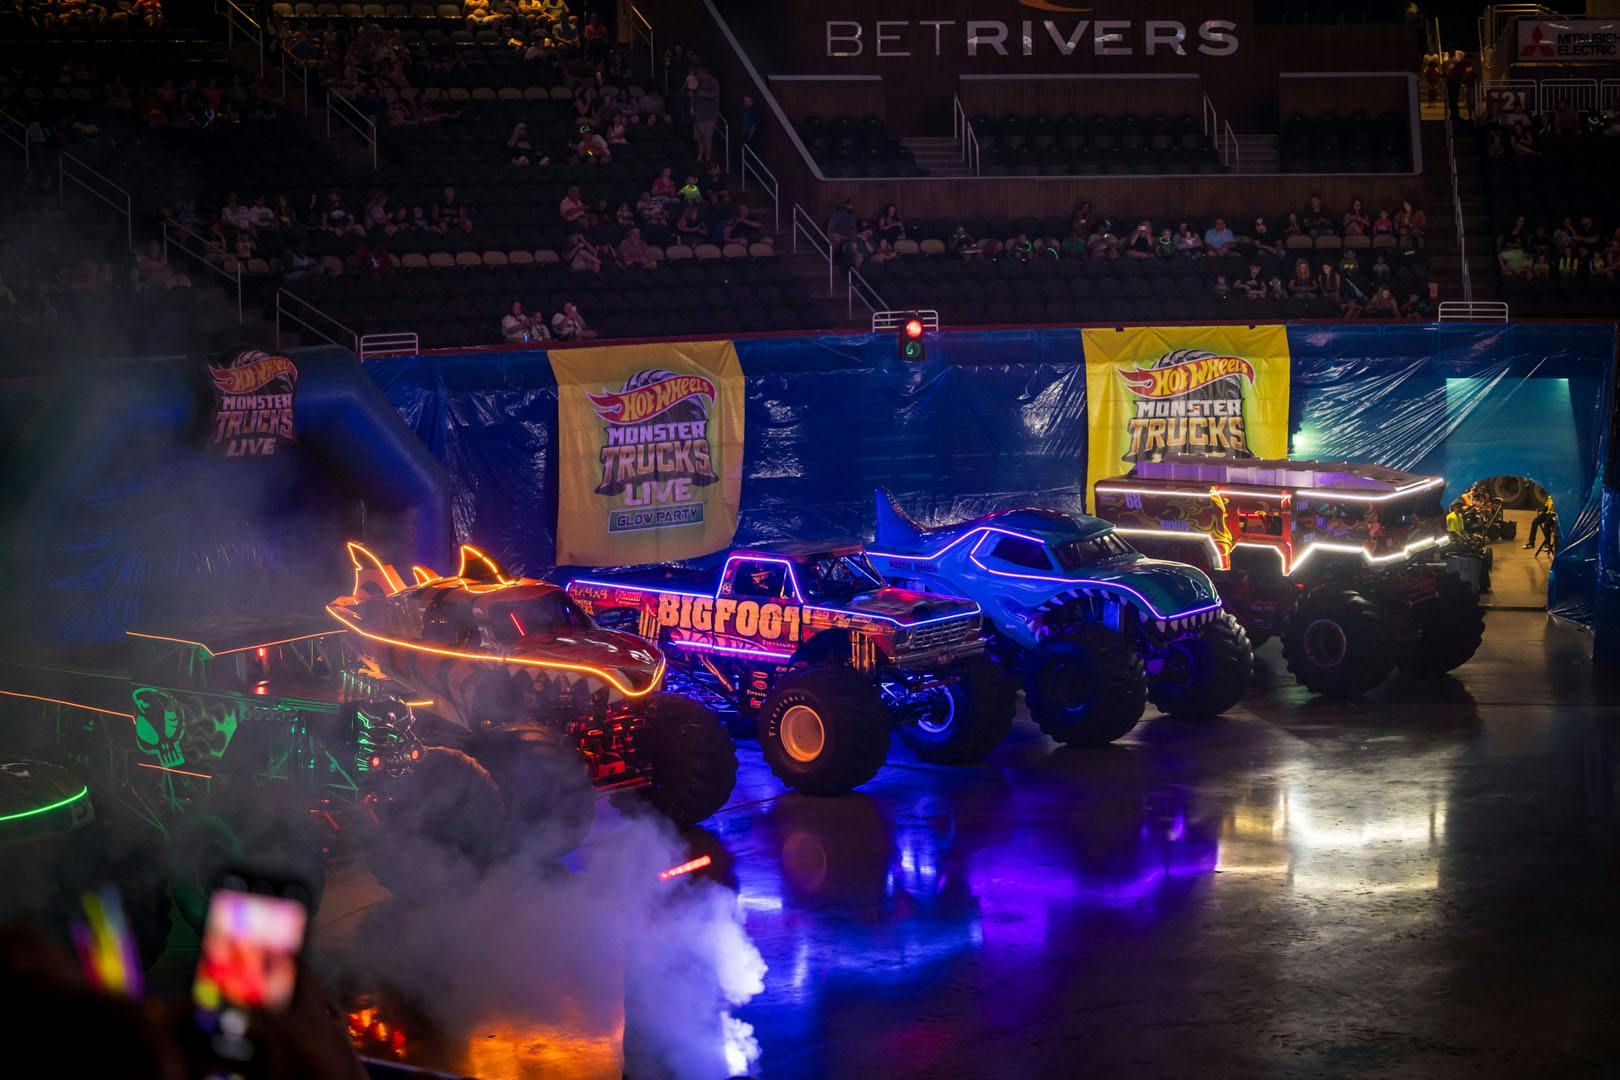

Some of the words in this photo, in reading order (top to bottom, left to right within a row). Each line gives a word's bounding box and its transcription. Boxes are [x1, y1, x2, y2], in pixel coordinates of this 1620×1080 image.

[825, 20, 1239, 57] BETRIVERS
[1557, 45, 1617, 56] ELECTRIC
[1151, 367, 1190, 396] HOT
[222, 394, 293, 411] MONSTER
[620, 390, 656, 422] HOT
[1134, 399, 1244, 417] MONSTER
[215, 409, 293, 445] TRUCKS
[606, 420, 708, 446] MONSTER
[1128, 417, 1251, 456] TRUCKS
[226, 438, 276, 457] LIVE
[601, 439, 716, 489] TRUCKS
[624, 477, 692, 506] LIVE
[617, 512, 654, 528] GLOW
[656, 508, 697, 523] PARTY
[658, 594, 812, 642] BIGFOOT
